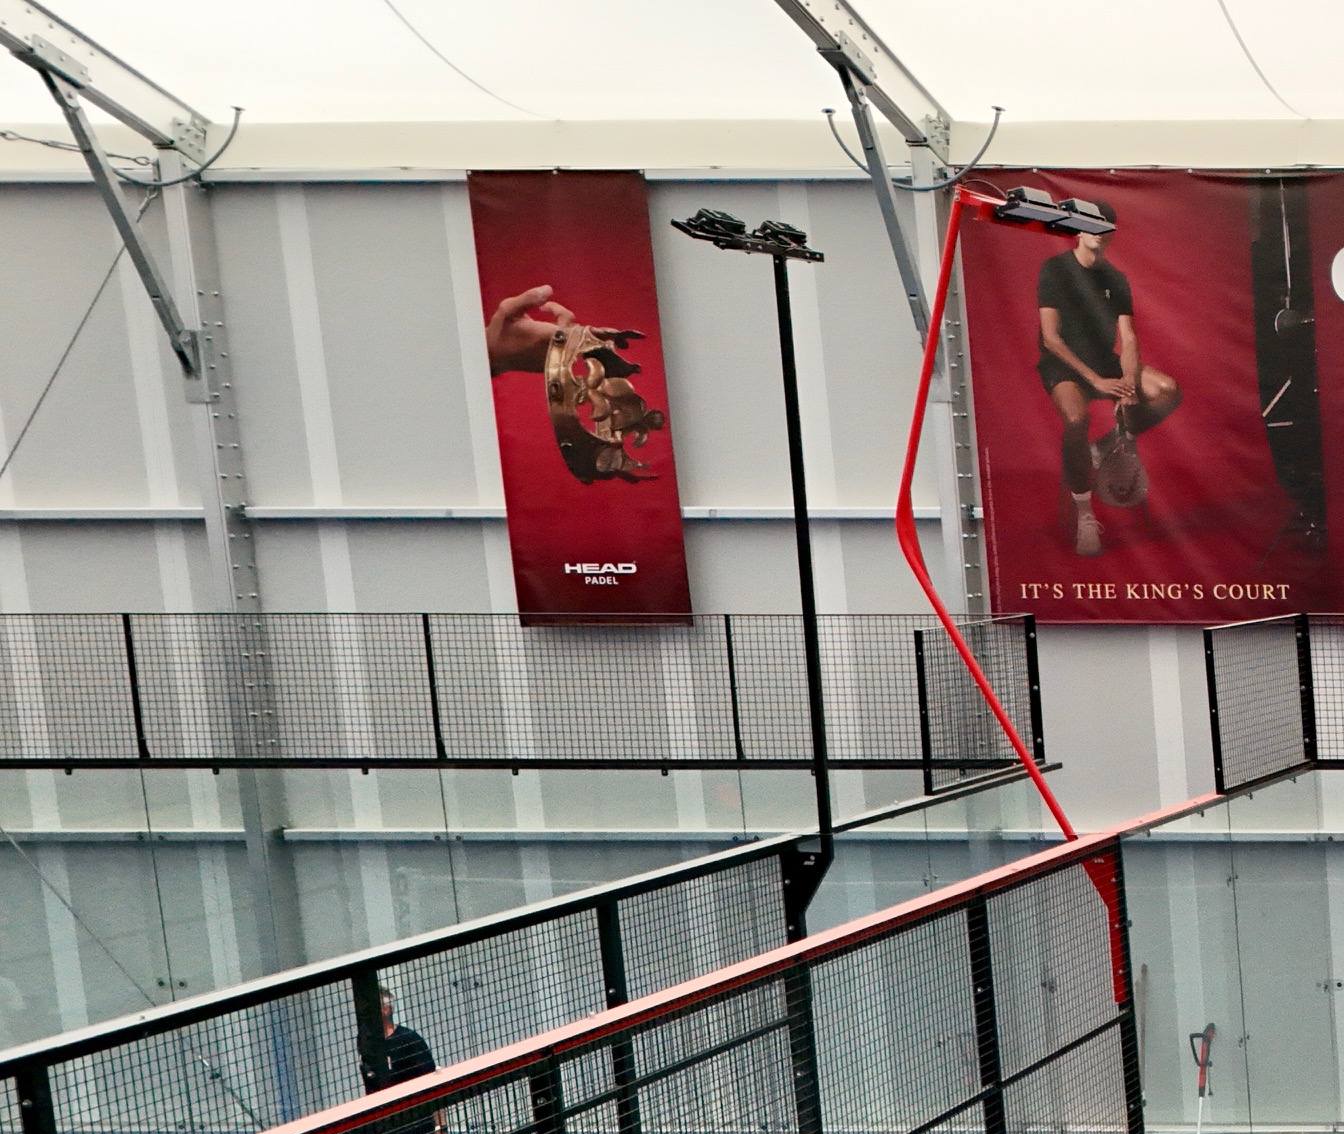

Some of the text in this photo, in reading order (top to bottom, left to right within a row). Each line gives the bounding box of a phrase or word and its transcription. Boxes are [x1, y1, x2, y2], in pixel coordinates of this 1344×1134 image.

[564, 562, 637, 574] HEAD
[584, 576, 619, 585] PADEL
[1072, 583, 1117, 600] THE
[1212, 584, 1290, 601] COURT
